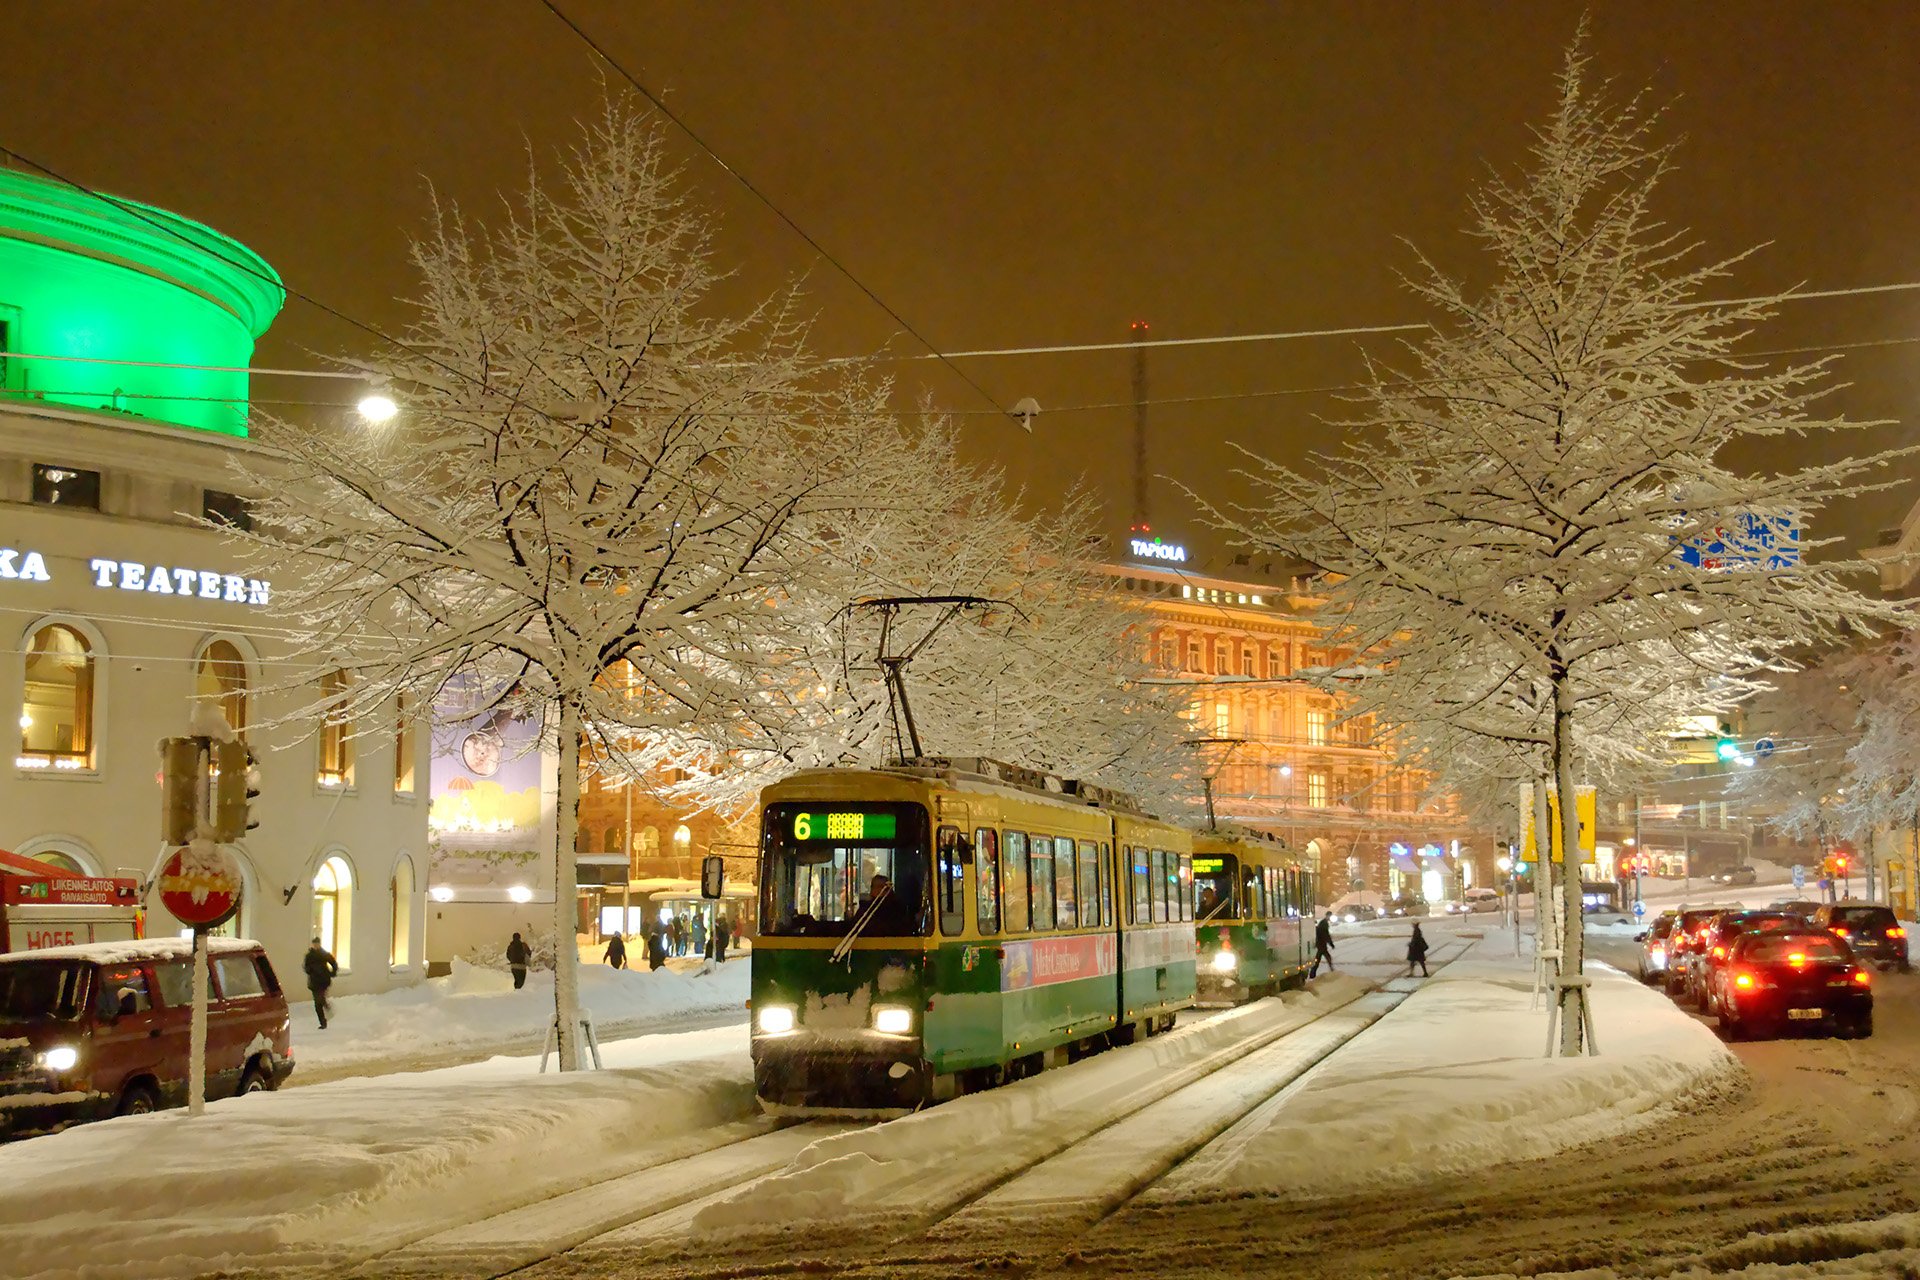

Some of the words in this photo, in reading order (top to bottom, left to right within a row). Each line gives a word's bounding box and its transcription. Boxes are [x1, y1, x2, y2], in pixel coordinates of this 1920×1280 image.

[1131, 538, 1185, 562] TAPIOLA
[0, 549, 50, 581] KA
[91, 558, 271, 605] TEATERN
[794, 813, 811, 840] 6
[827, 813, 864, 827] ARABIA
[827, 826, 864, 839] ARABIA
[51, 879, 115, 892] LIIKENNELAITOS
[61, 892, 107, 903] RAIVAUSAUTO
